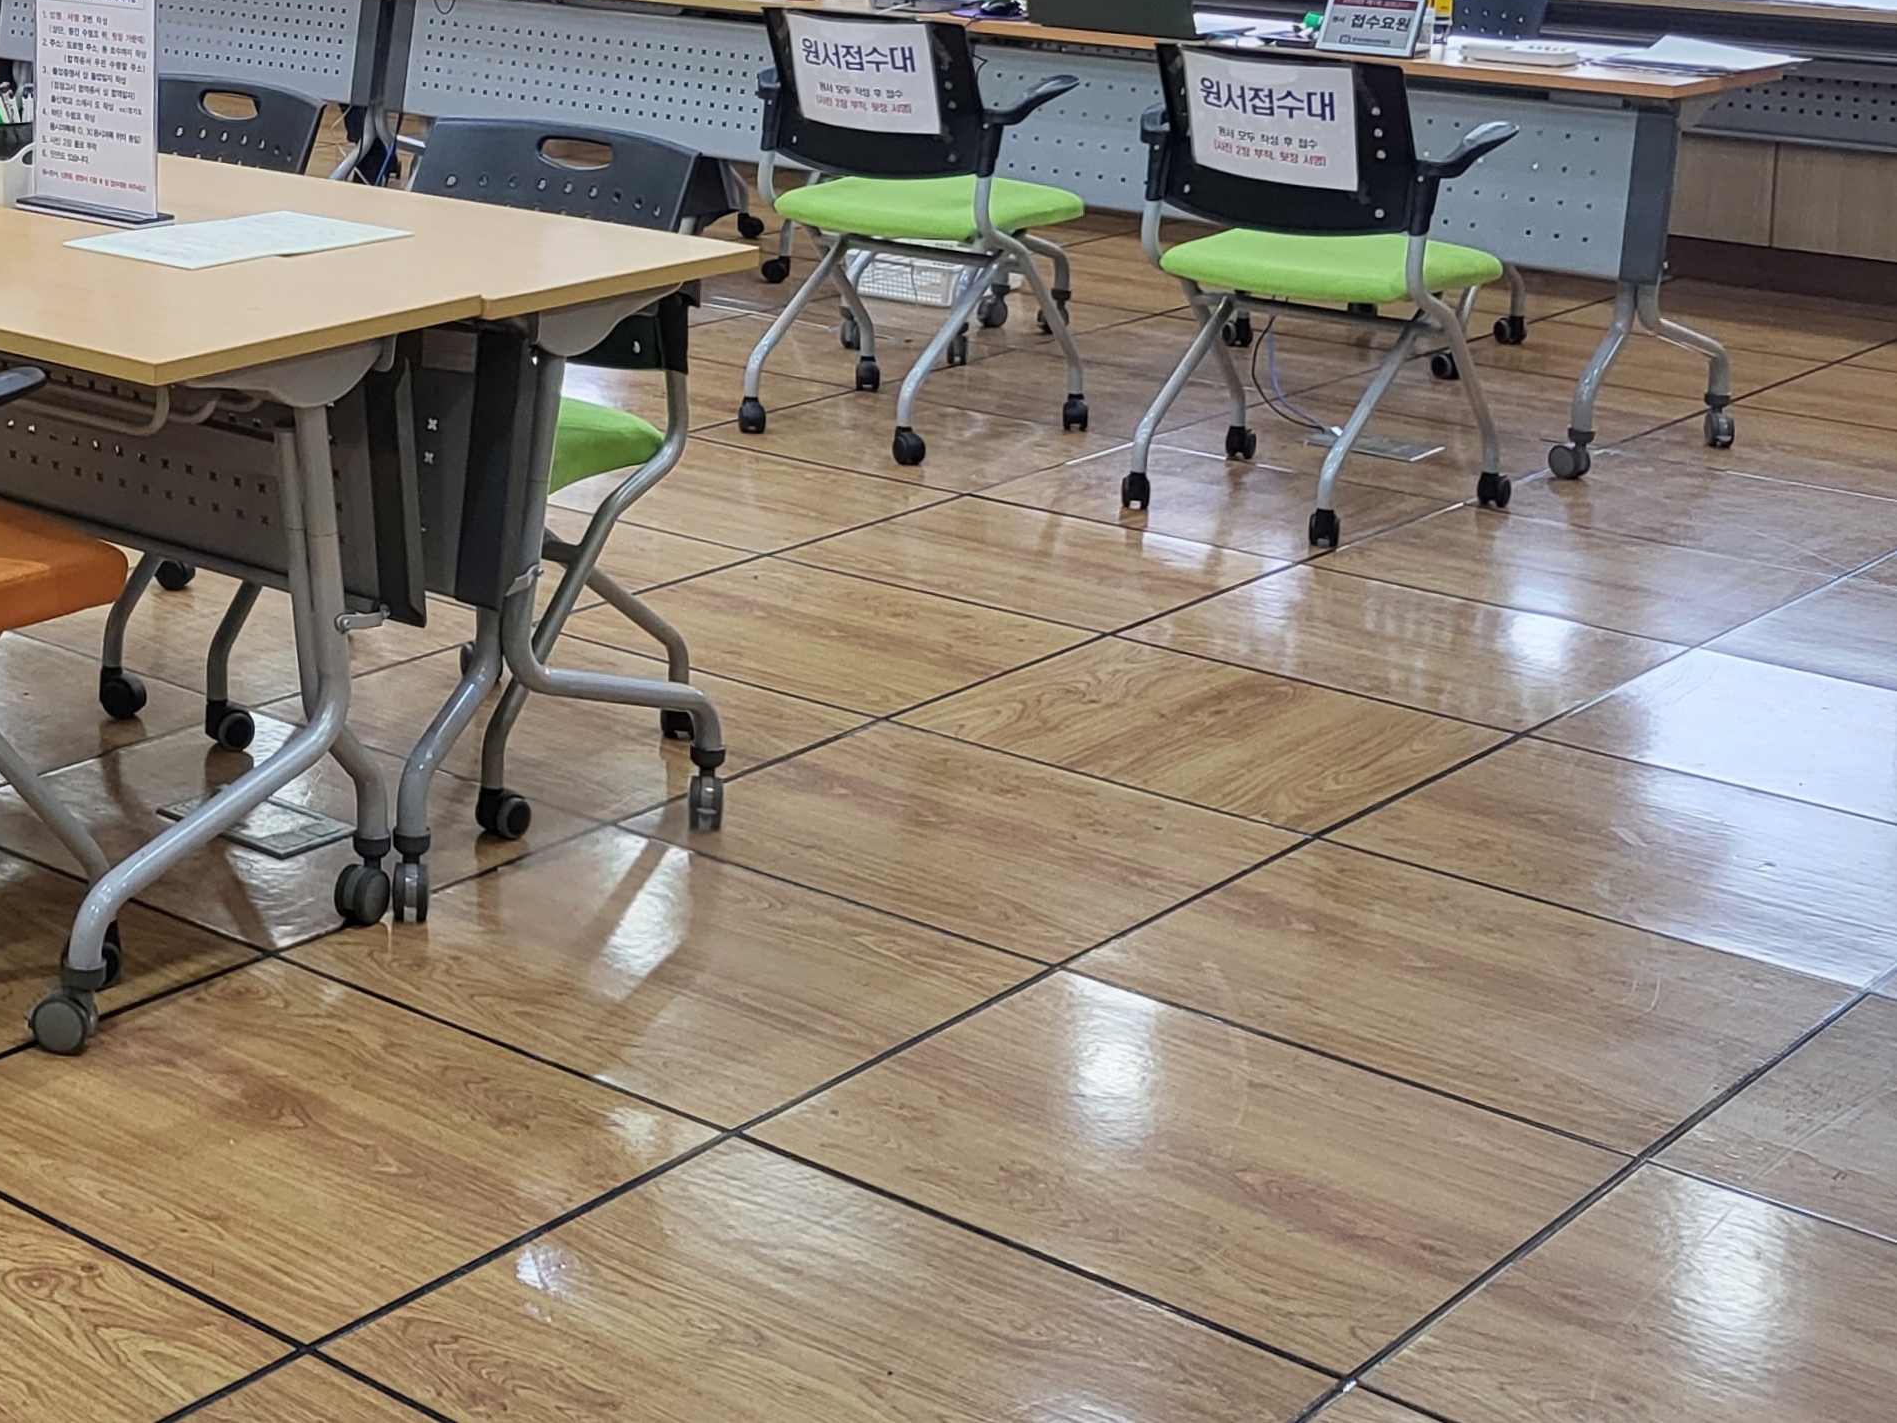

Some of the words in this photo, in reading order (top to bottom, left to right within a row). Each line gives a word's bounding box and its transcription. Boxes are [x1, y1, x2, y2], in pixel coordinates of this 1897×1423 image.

[1351, 14, 1411, 32] 접수요원
[802, 38, 916, 73] 원서접수대
[818, 81, 833, 93] 원서
[836, 85, 851, 95] 모두
[854, 87, 870, 98] 작성
[874, 89, 882, 98] 후
[885, 89, 903, 99] 접수
[835, 98, 848, 109] 2장
[1199, 77, 1335, 122] 원서접수대
[1218, 126, 1234, 139] 원서
[1237, 130, 1255, 143] 모두
[1260, 133, 1279, 146] 작성
[1284, 137, 1293, 147] 후
[1298, 138, 1318, 150] 접수
[1235, 145, 1250, 157] 2장
